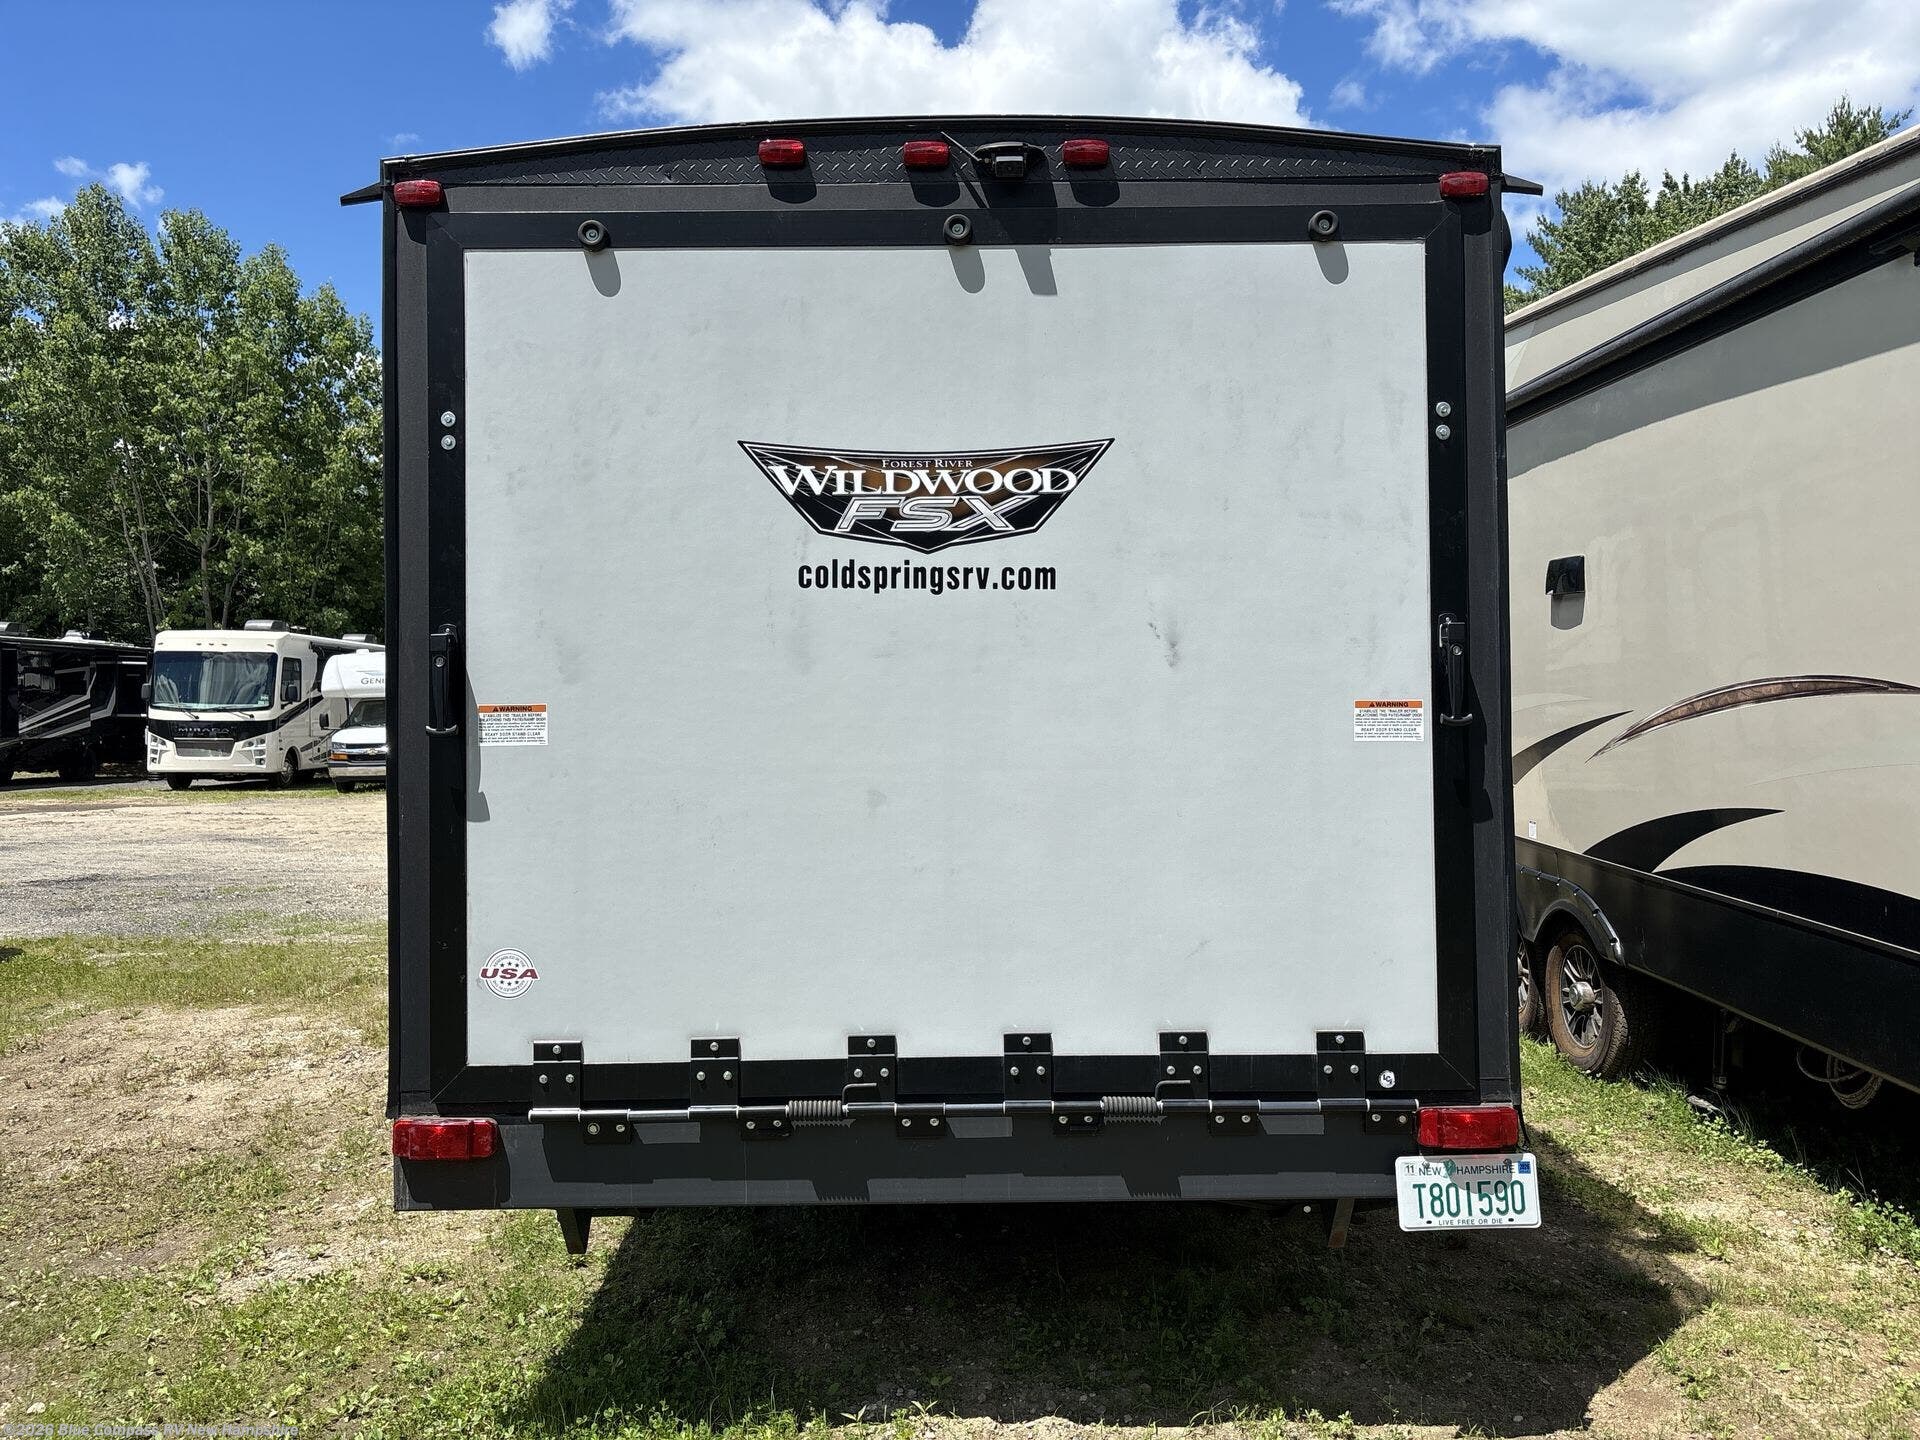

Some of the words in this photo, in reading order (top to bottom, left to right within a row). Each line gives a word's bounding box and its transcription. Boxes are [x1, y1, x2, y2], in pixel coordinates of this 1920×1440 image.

[882, 459, 932, 469] FOREST
[934, 459, 973, 468] RIVER
[767, 465, 1078, 496] WILDWOOD
[834, 495, 1040, 532] FSX
[798, 558, 1057, 595] coldspringsrv.com
[481, 968, 539, 979] USA
[1406, 1165, 1415, 1174] 11
[1418, 1167, 1442, 1176] NEW
[1456, 1164, 1516, 1175] HAMPSHIRE
